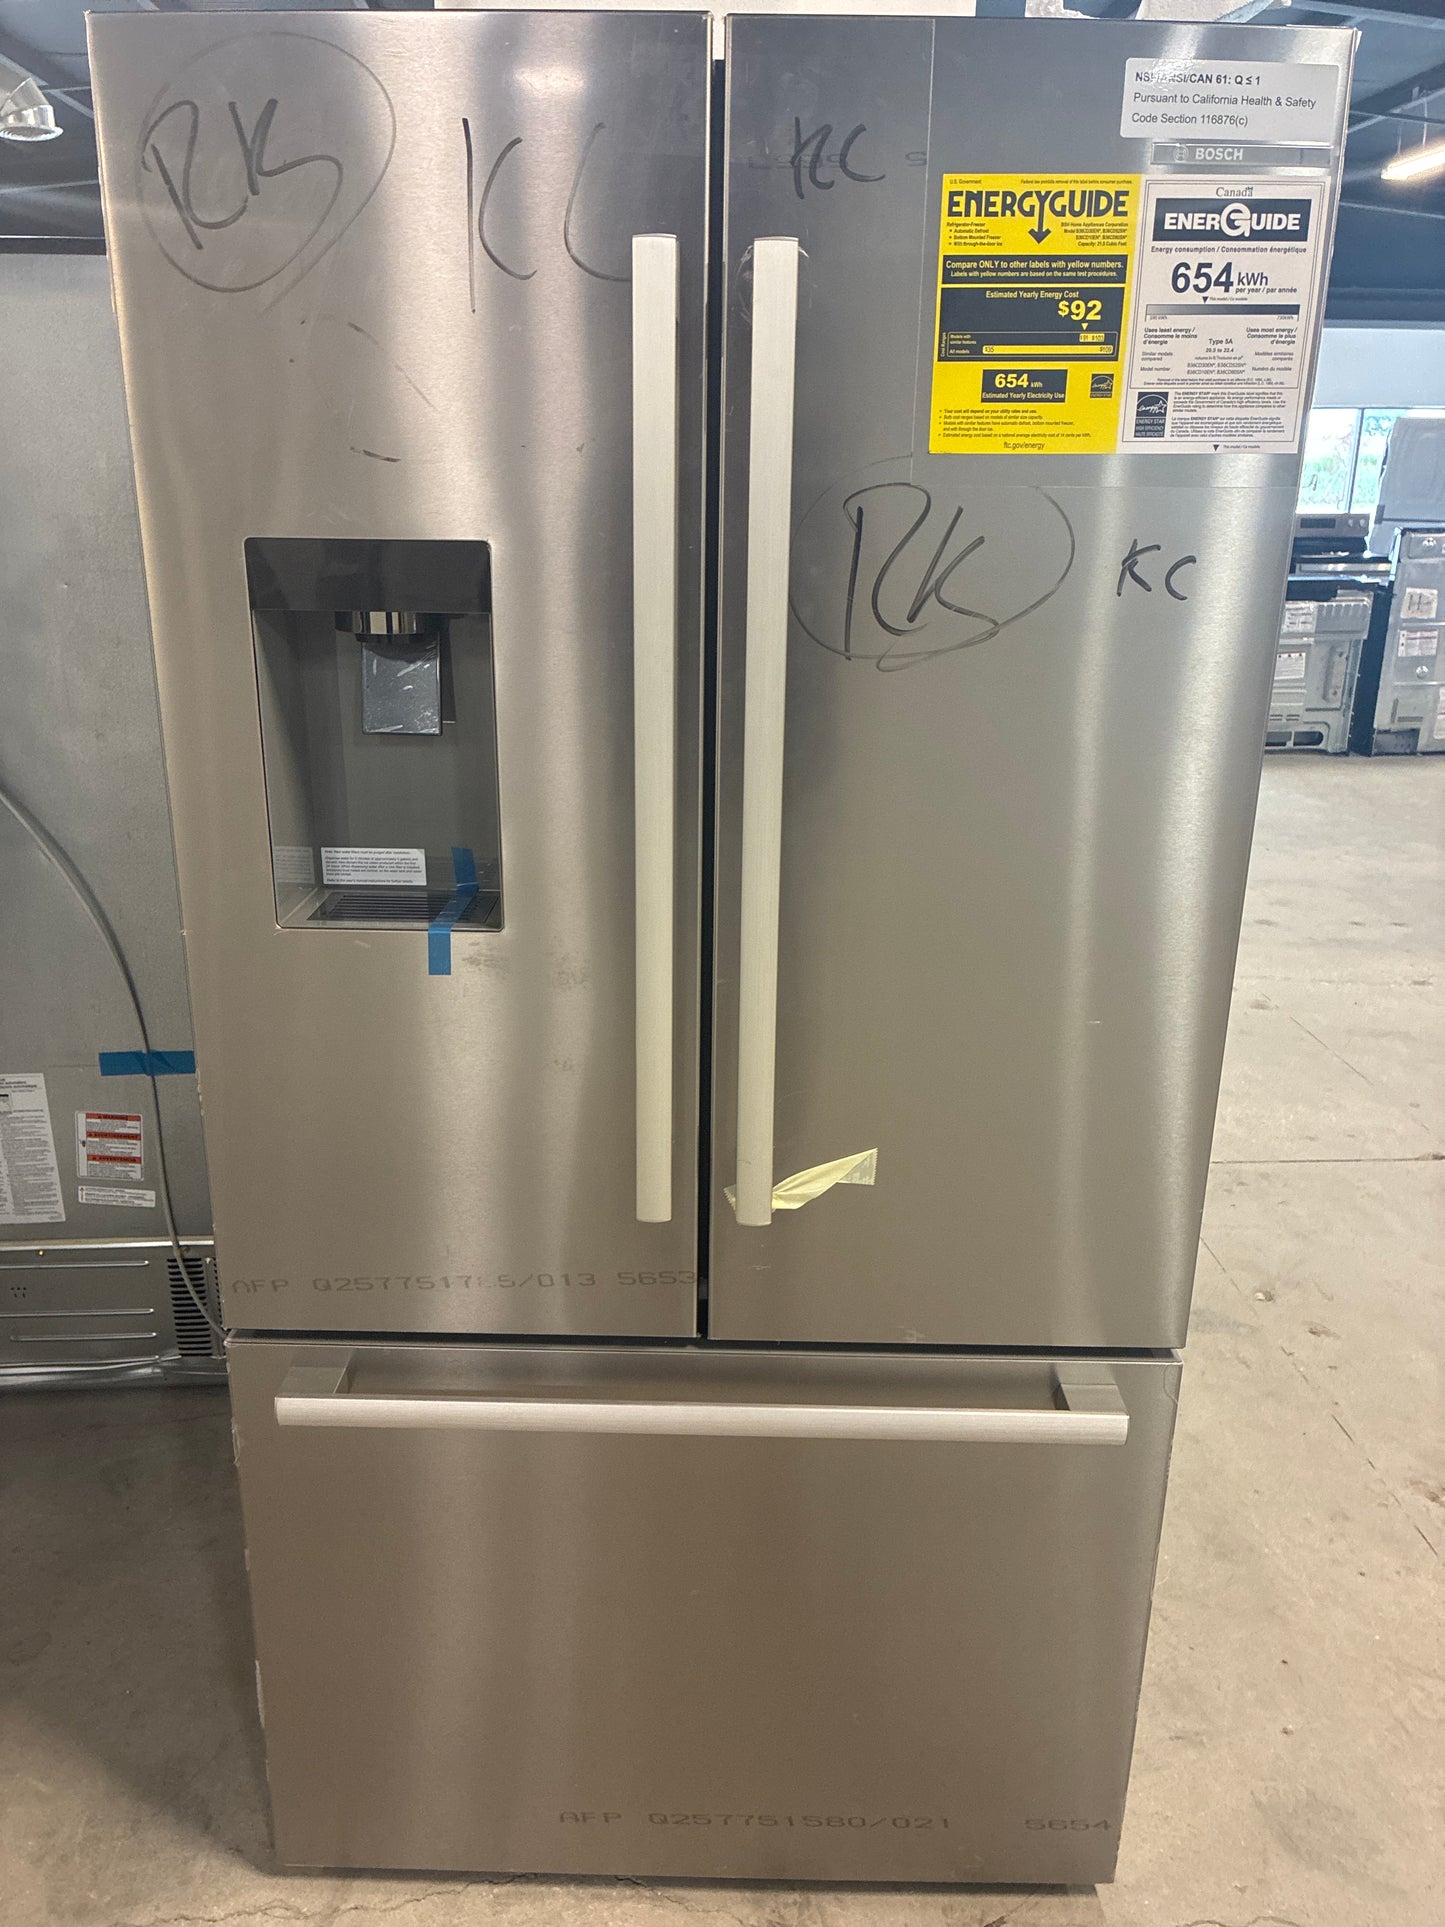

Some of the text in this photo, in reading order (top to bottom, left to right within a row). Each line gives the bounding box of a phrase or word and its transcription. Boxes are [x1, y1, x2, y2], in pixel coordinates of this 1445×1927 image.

[1216, 74, 1231, 85] 61:
[1234, 74, 1243, 86] Q
[1255, 75, 1261, 85] 1
[1133, 92, 1317, 110] Pursuant to California Health & Safety
[1131, 112, 1248, 127] Code Section 116876(c)
[1195, 148, 1244, 160] BOSCH
[1216, 187, 1253, 197] Canada
[948, 190, 1129, 217] ENERGYGUIDE
[1164, 202, 1301, 237] ENERGUIDE
[1151, 246, 1173, 254] Energy
[1175, 246, 1215, 254] consumption
[946, 260, 1124, 271] Compare ONLY to other labels with yellow numbers.
[1172, 262, 1268, 293] 654 kWh
[986, 290, 1079, 299] Estimated Yearly Energy Cost
[1235, 286, 1246, 294] per
[1247, 286, 1261, 294] year
[1266, 286, 1276, 294] par
[1058, 300, 1102, 321] $92
[995, 374, 1029, 388] 654
[982, 392, 1064, 400] Estimated Yearly Electricity Use
[1004, 442, 1046, 450] ftc.gov/energy
[232, 1270, 695, 1293] AFP Q25775175/013 5653
[559, 1811, 622, 1823] AFP
